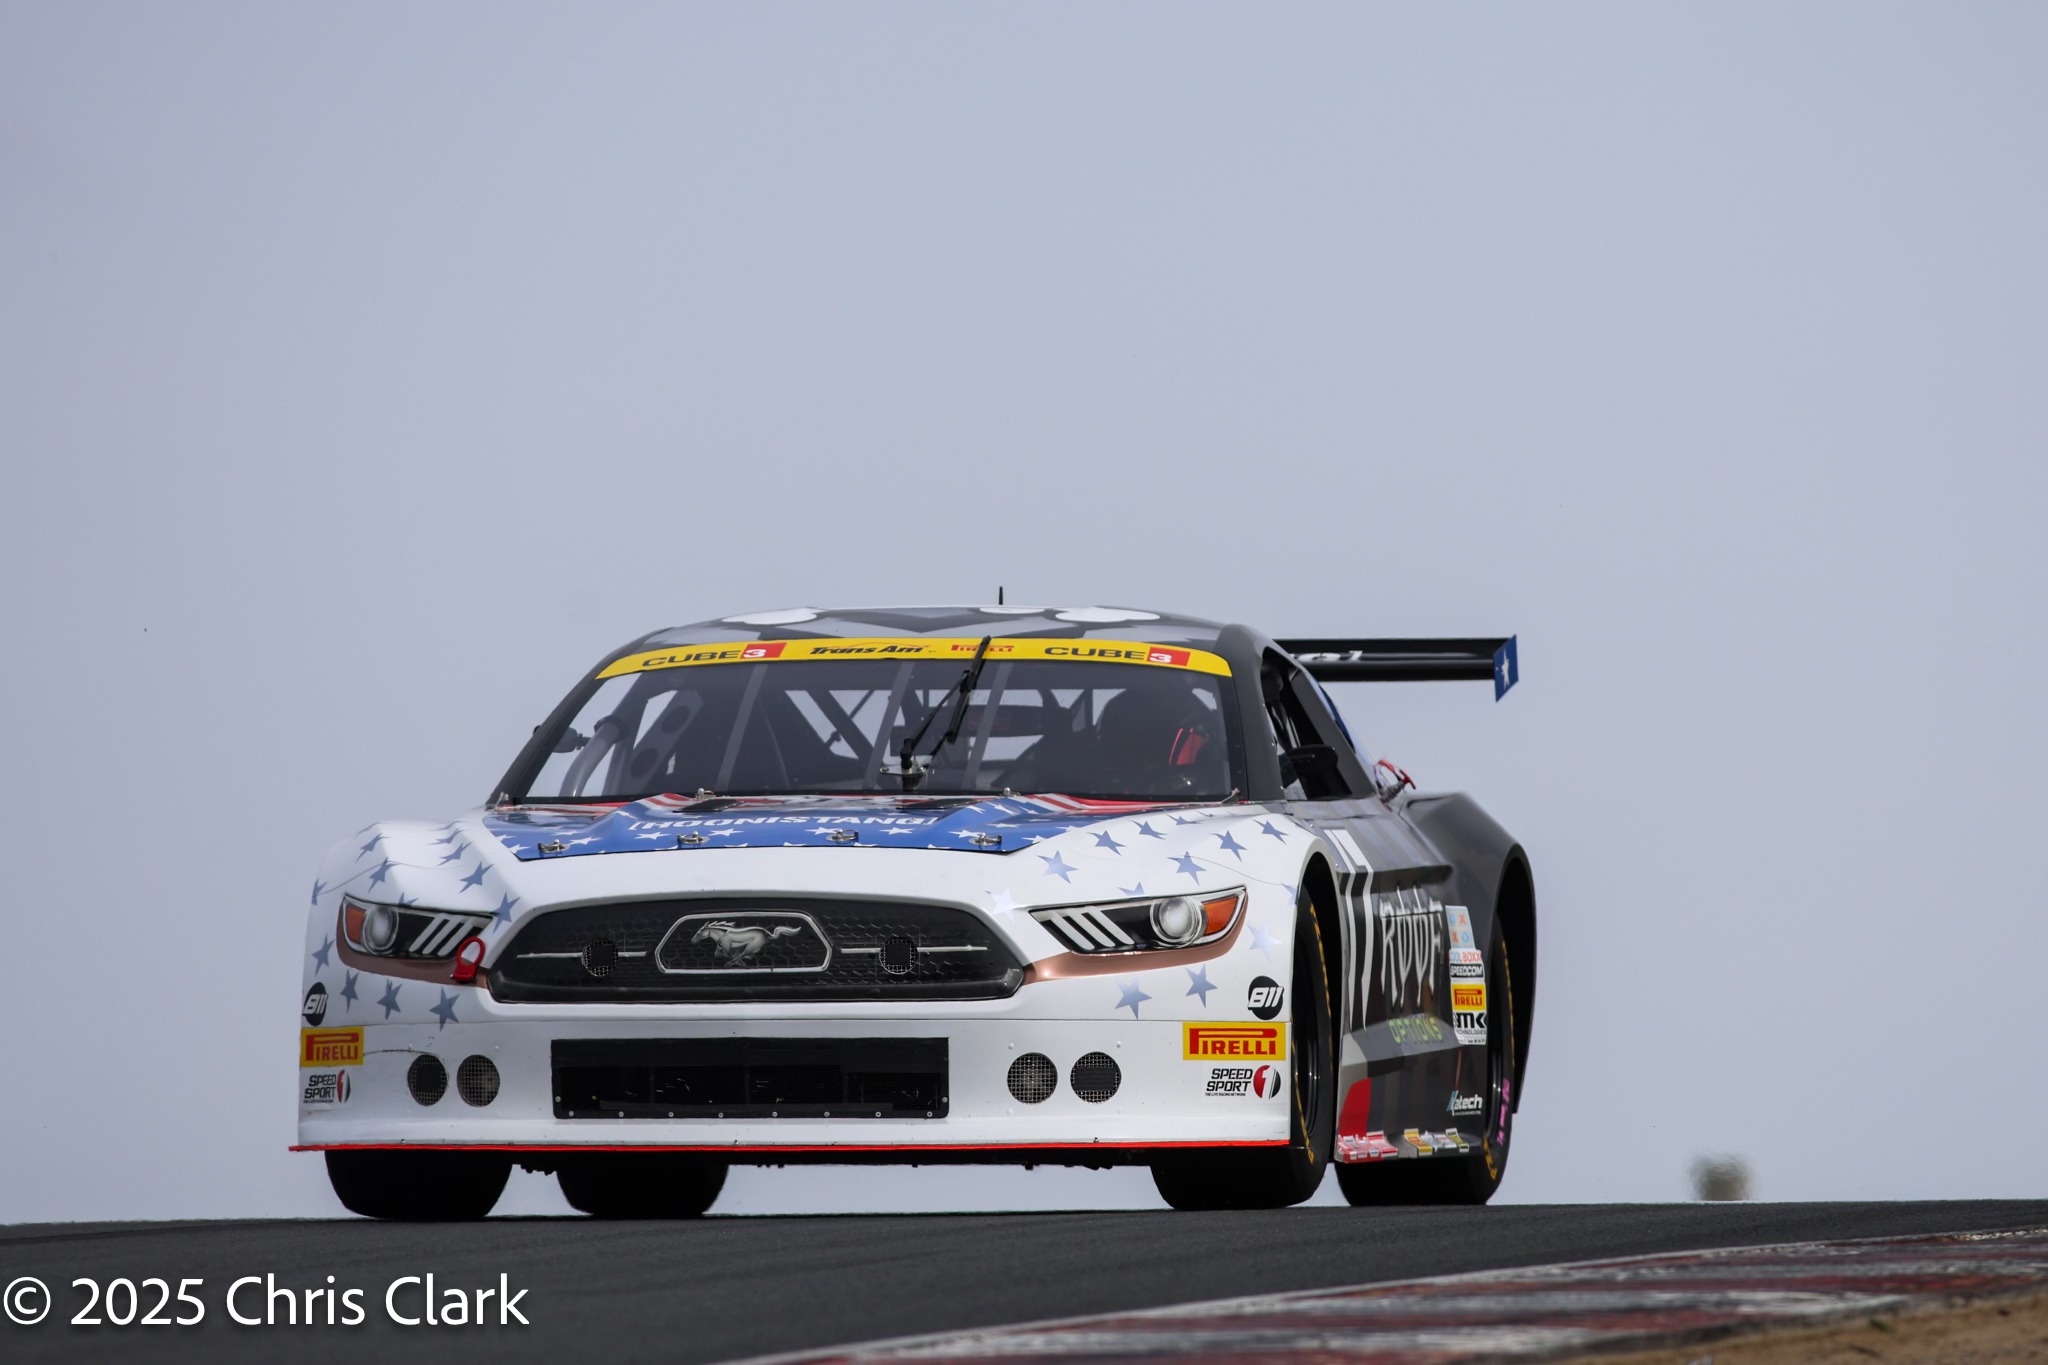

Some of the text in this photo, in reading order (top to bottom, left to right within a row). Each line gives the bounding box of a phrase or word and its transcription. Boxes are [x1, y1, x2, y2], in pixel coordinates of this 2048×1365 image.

[809, 646, 876, 655] Trans
[877, 645, 923, 654] Am
[1450, 965, 1483, 977] SPEEDCOM
[1454, 988, 1482, 1006] PIRELLI
[1388, 1016, 1444, 1044] OPTIONS
[305, 1032, 360, 1061] PIRELLI
[1189, 1028, 1278, 1055] PIRELLI
[308, 1074, 337, 1087] SPEED
[1211, 1068, 1253, 1080] SPEED
[304, 1086, 336, 1099] SPORT
[1206, 1080, 1251, 1092] SPORT
